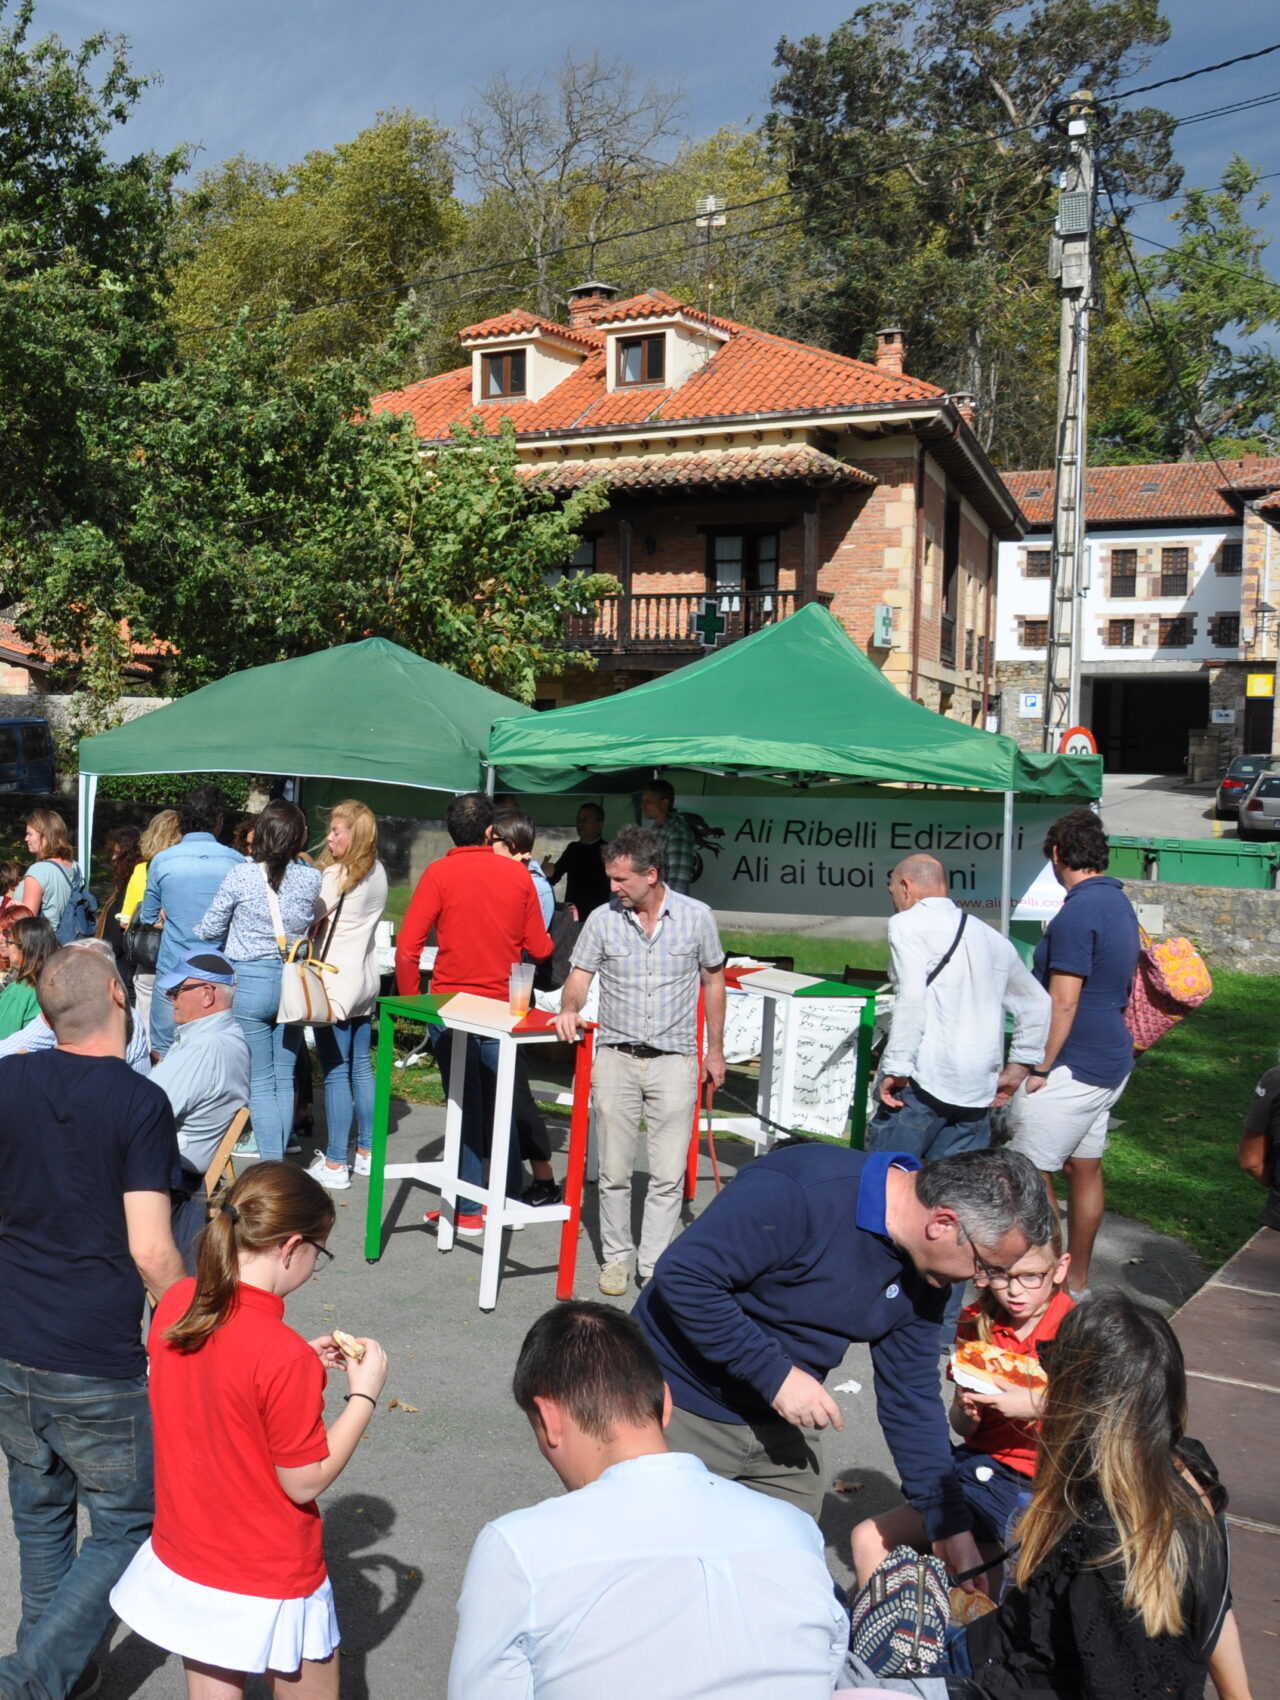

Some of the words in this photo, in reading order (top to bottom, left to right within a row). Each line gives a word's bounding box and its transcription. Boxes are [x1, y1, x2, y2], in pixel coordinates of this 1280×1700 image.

[734, 818, 773, 843] Ali
[783, 819, 876, 848] Ribelli
[890, 822, 1024, 850] Edizioni
[732, 855, 768, 882] Ali
[780, 859, 805, 884] ai
[817, 861, 873, 888] tuoi
